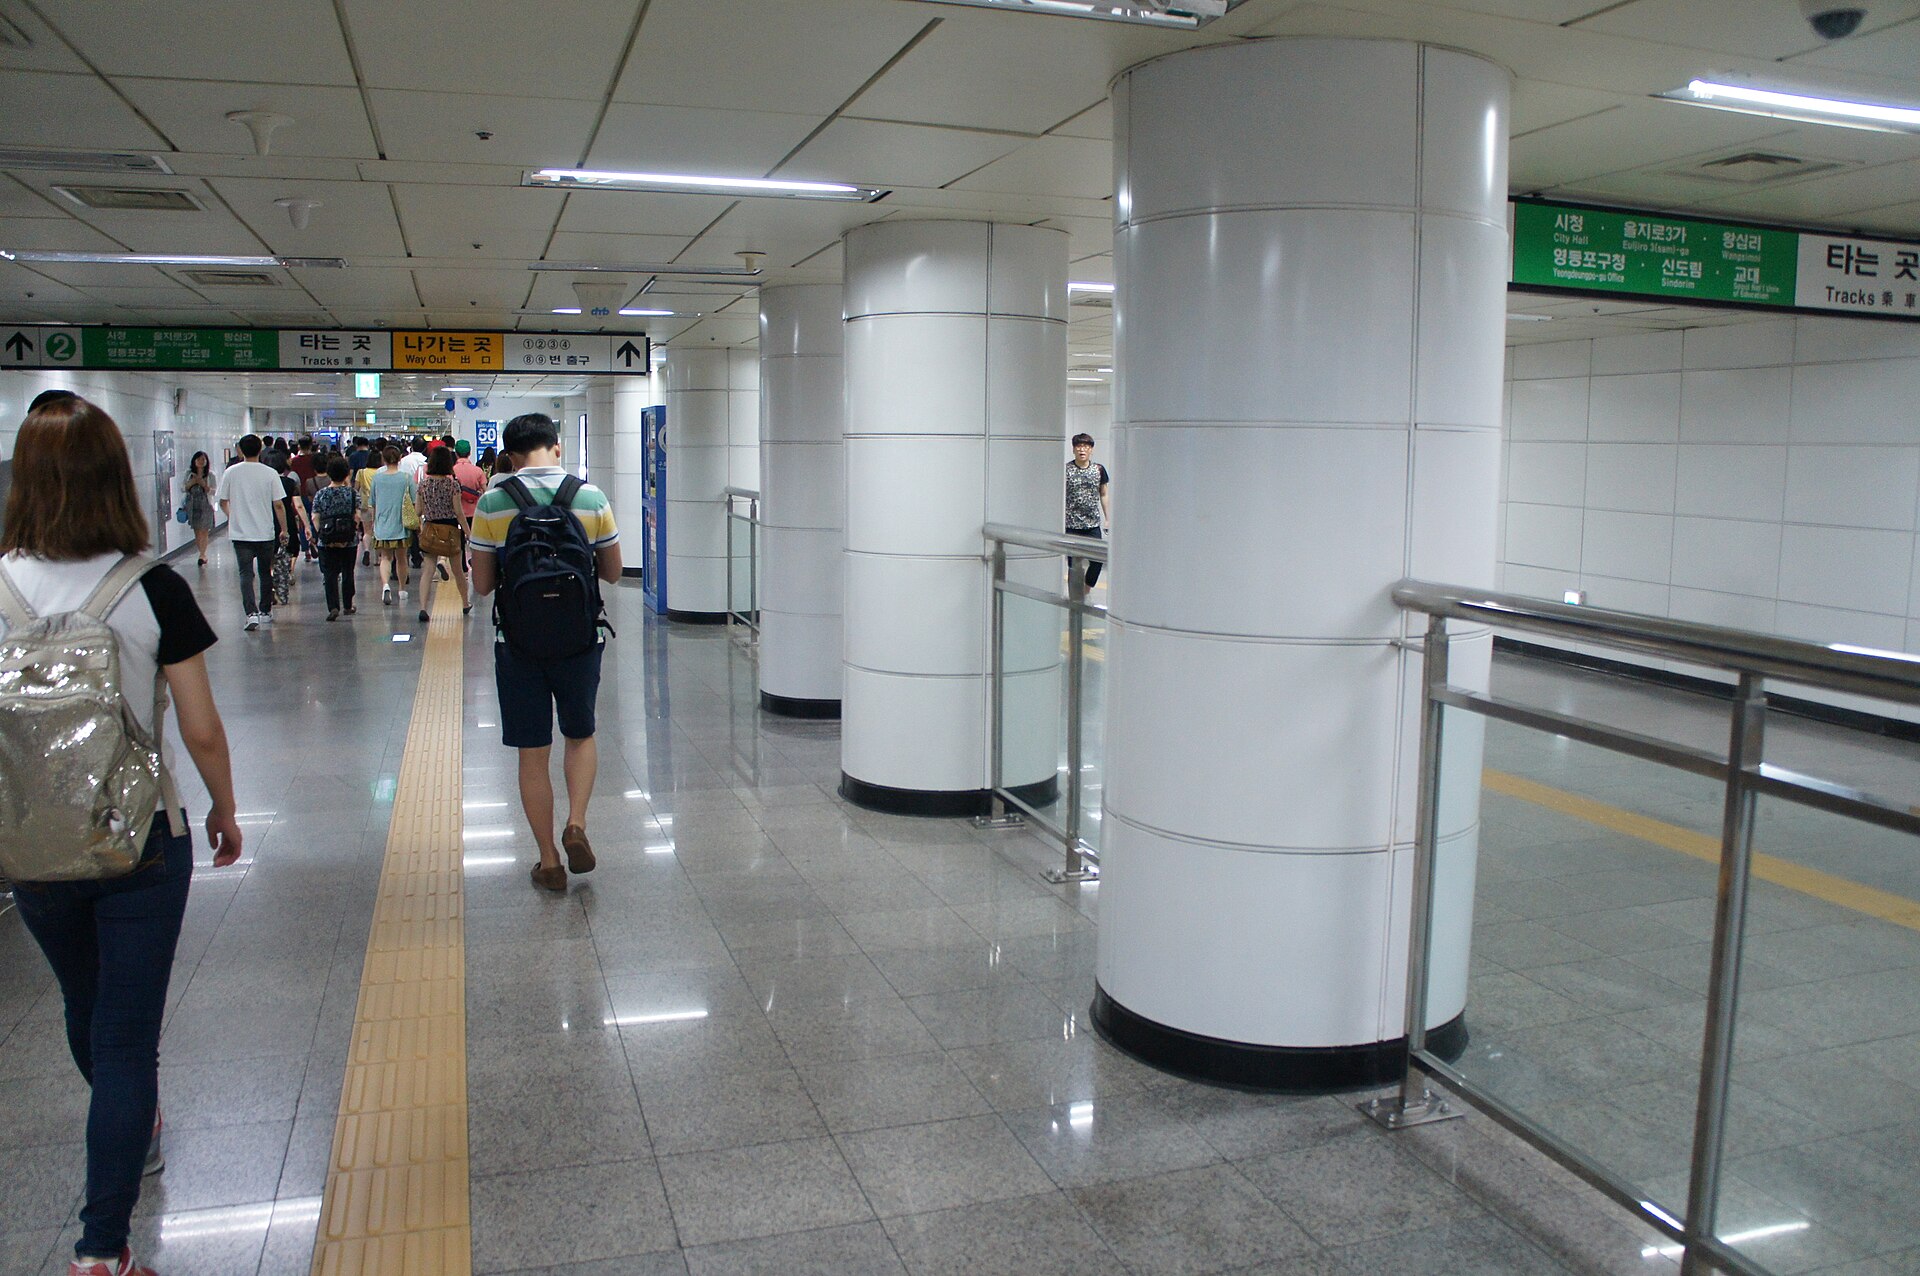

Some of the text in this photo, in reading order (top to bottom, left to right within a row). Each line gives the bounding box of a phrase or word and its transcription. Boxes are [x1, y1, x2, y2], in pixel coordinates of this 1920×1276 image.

[1553, 232, 1589, 245] City Hall
[1554, 213, 1762, 252] 시청 을지로3가 왕십리
[1554, 248, 1760, 285] 영등포구청 신도림 교대
[1827, 244, 1919, 280] 타는 곳
[1608, 272, 1625, 283] Office
[1661, 277, 1696, 289] Sindorim
[1826, 285, 1876, 306] Tracks
[106, 331, 126, 341] 시청
[300, 334, 372, 351] 타는 곳
[51, 334, 72, 359] 2
[404, 335, 491, 353] 나가는 곳
[301, 356, 340, 366] Tracks
[405, 354, 447, 366] Way Out
[566, 355, 590, 366] 출구
[478, 428, 497, 442] 50
